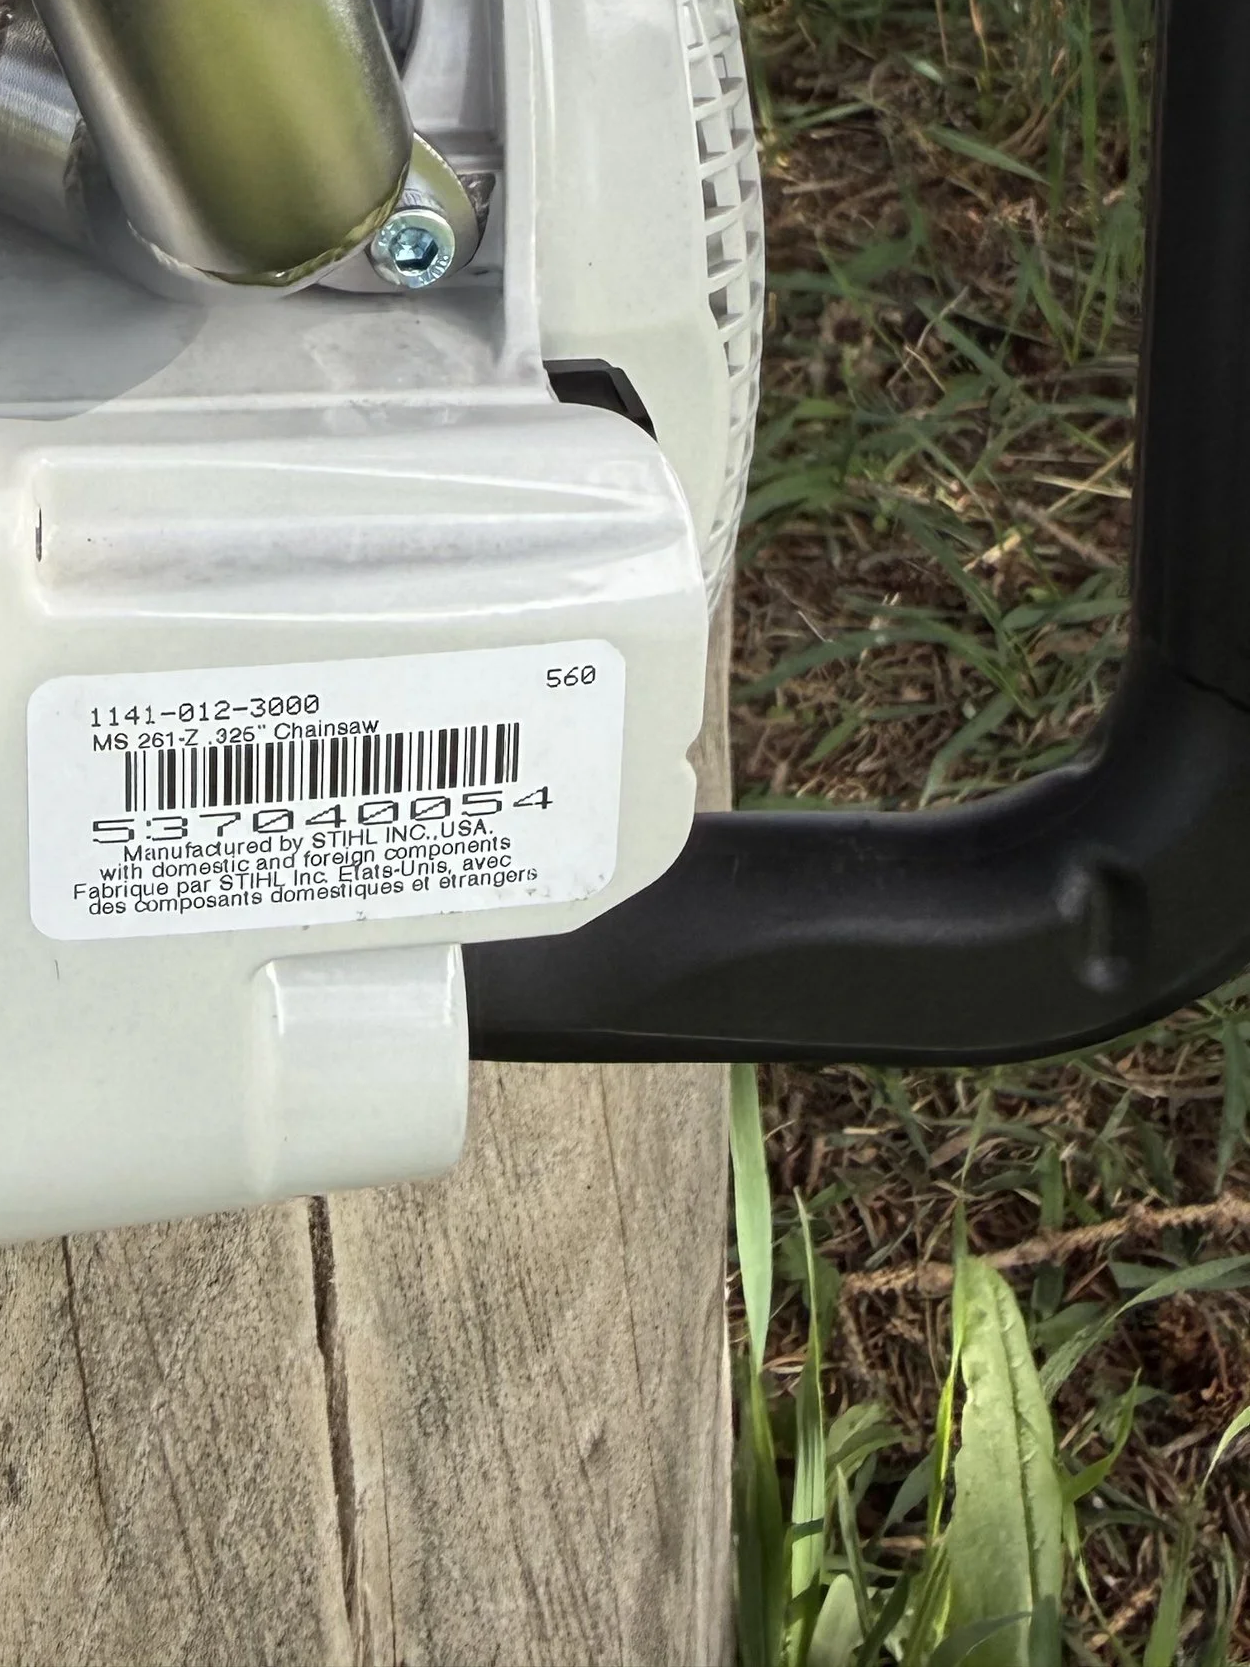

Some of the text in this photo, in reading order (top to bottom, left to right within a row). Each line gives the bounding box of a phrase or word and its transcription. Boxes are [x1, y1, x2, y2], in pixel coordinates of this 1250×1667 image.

[546, 665, 596, 687] 560
[91, 694, 320, 727] 1141-012-3000
[93, 733, 129, 752] MS
[138, 728, 199, 749] 261-Z
[274, 719, 380, 740] Chainsaw
[100, 836, 511, 881] with domestic and foreign components
[124, 836, 272, 862] Manufactured
[280, 835, 304, 854] by
[312, 828, 378, 849] STIHL
[74, 880, 169, 902] Fabrique
[177, 878, 211, 898] par
[219, 872, 285, 892] STIHL
[463, 854, 512, 871] avec
[89, 868, 538, 915] des composants domestiques et etrangers
